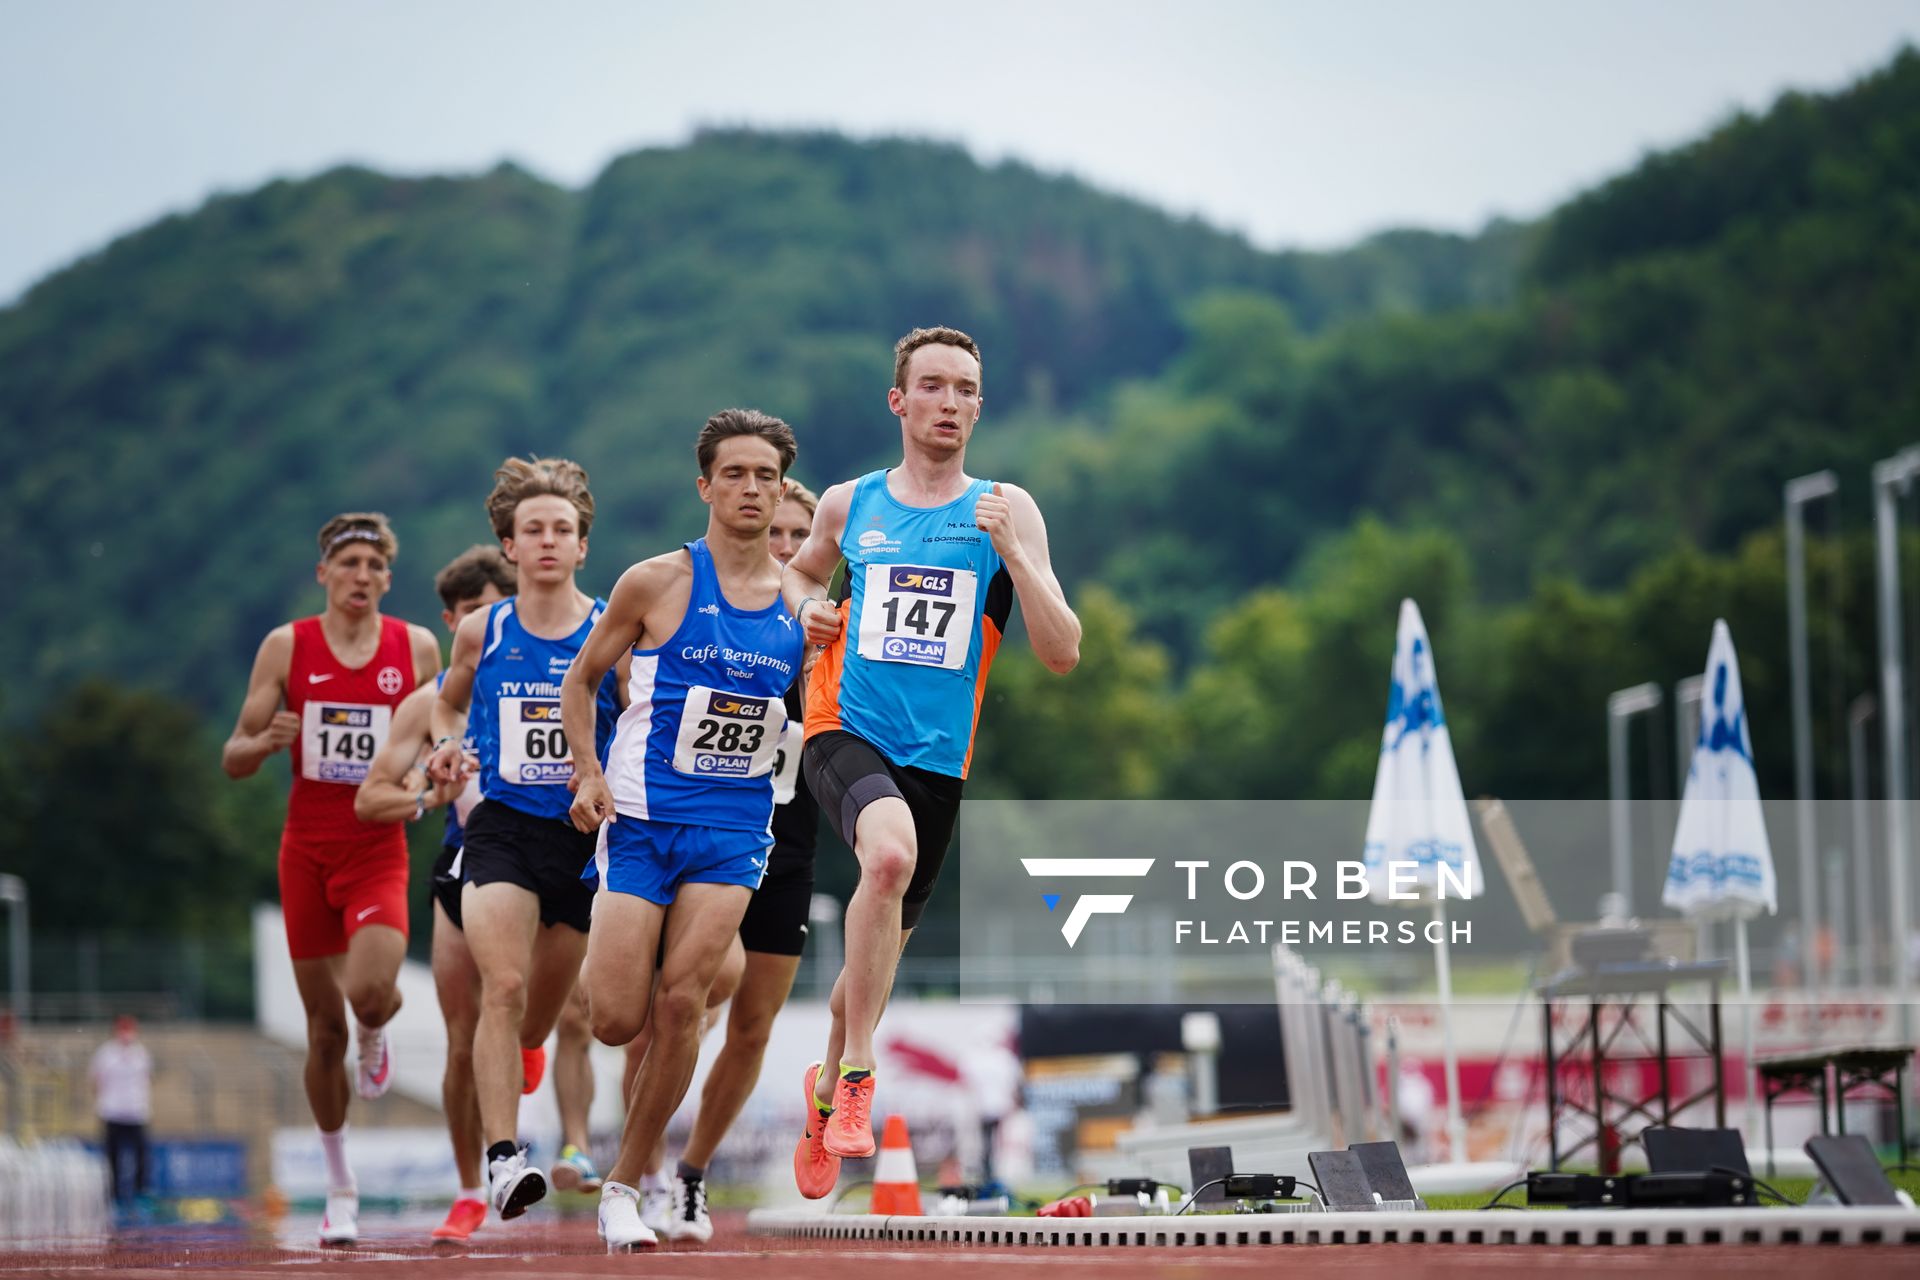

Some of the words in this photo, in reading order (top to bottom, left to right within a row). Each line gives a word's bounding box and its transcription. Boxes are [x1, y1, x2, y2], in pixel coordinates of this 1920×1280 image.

[922, 576, 948, 591] GLS
[882, 597, 956, 638] 147
[909, 642, 944, 657] PLAN
[681, 645, 718, 663] Café
[723, 648, 791, 675] Benjamin
[726, 667, 754, 679] Trebur
[738, 703, 764, 717] GLS
[526, 728, 568, 759] 60
[692, 719, 765, 753] 283
[317, 730, 375, 761] 149
[542, 765, 574, 776] PLAN
[717, 757, 749, 769] PLAN
